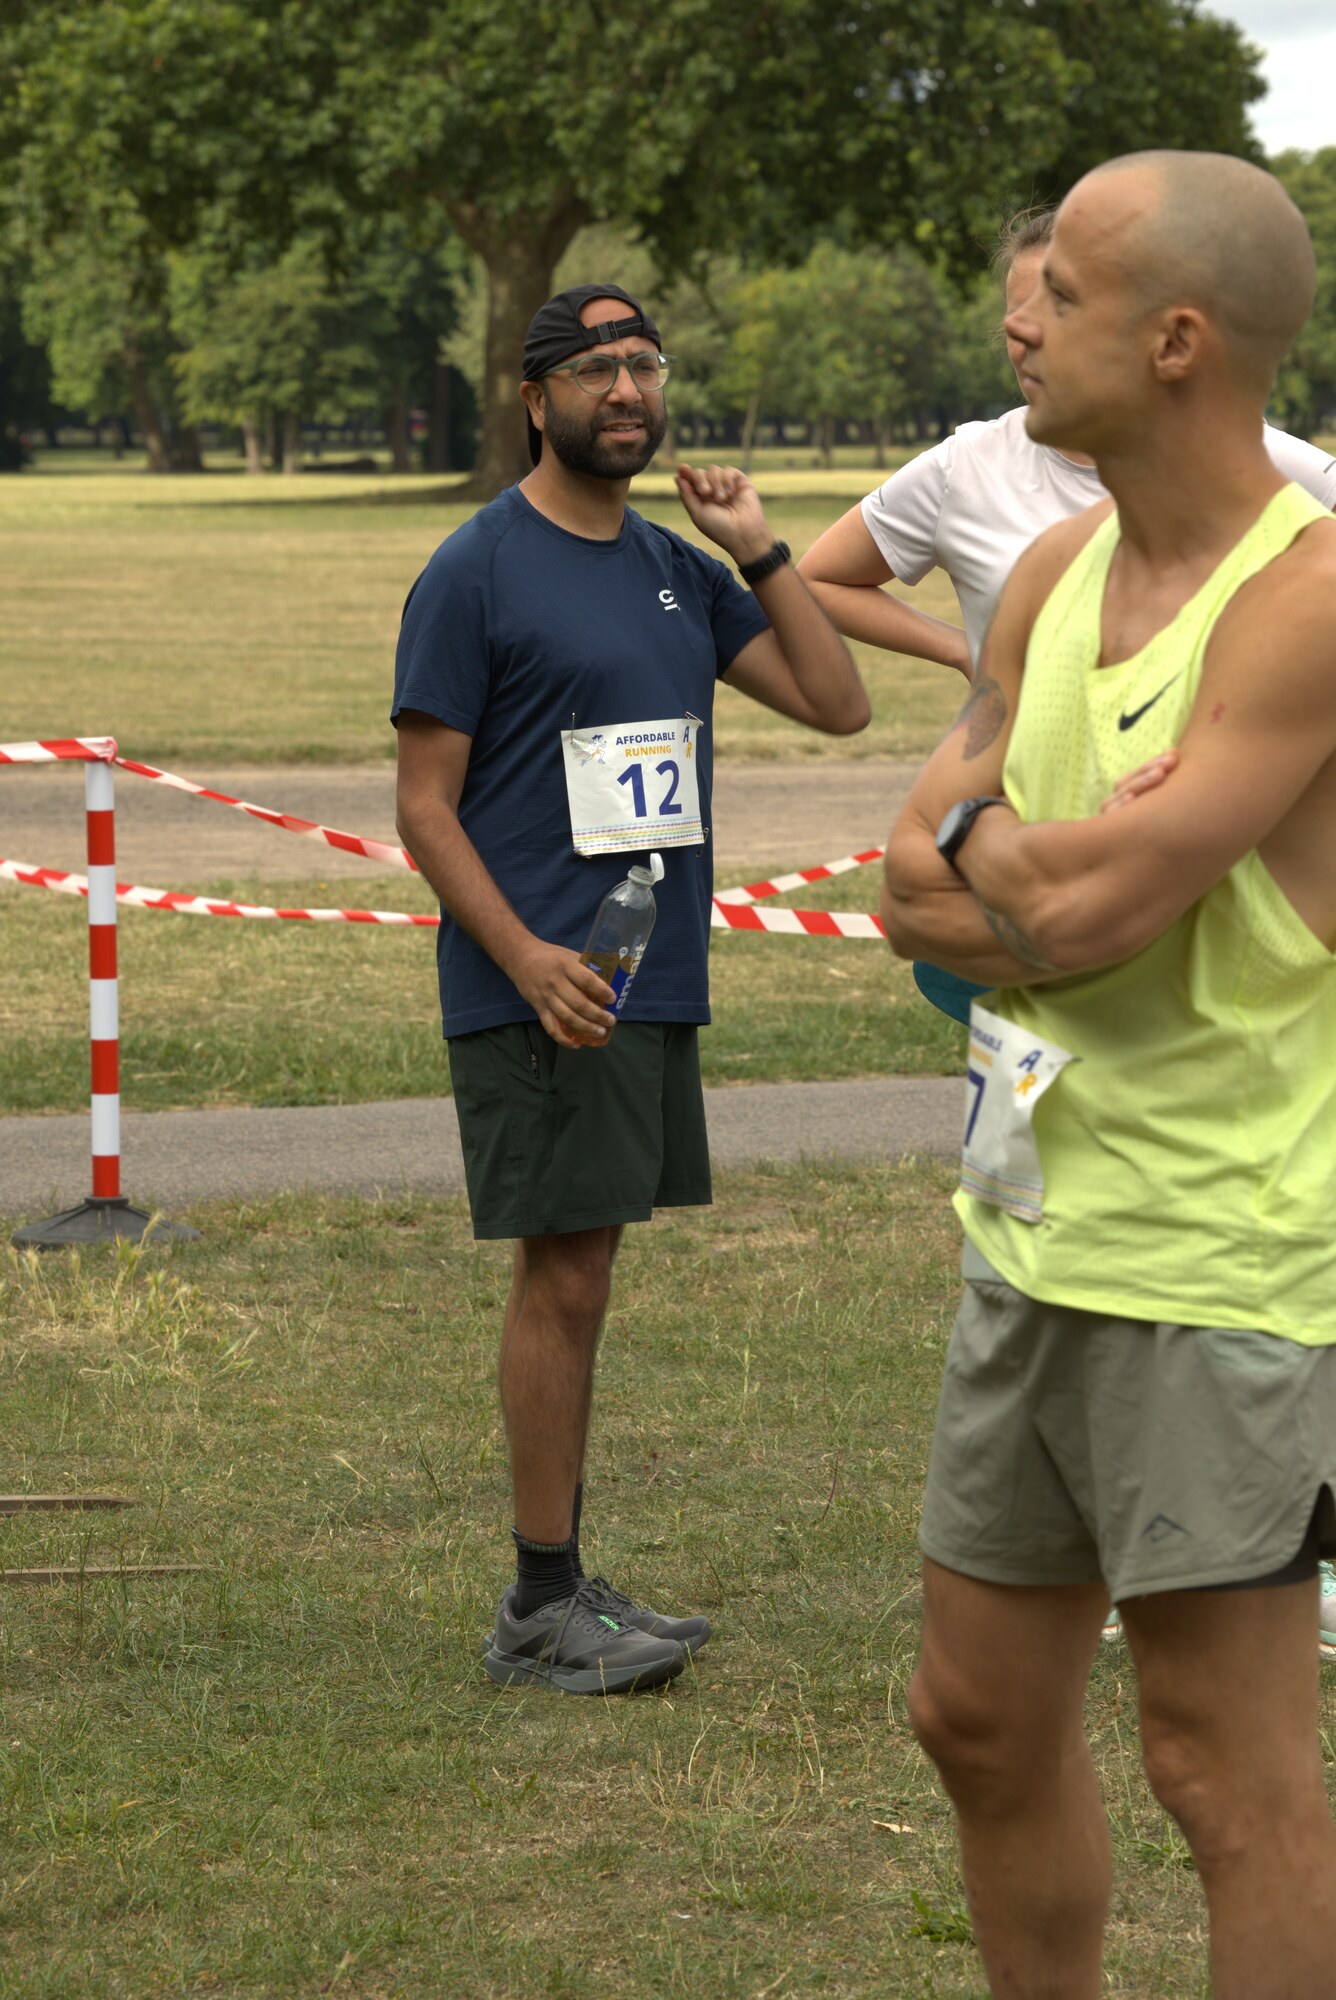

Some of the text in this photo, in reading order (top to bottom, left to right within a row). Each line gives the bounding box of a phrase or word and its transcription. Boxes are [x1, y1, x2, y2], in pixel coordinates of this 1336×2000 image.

[615, 731, 676, 746] AFFORDABLE
[625, 744, 672, 758] RUNNING
[616, 759, 683, 818] 12
